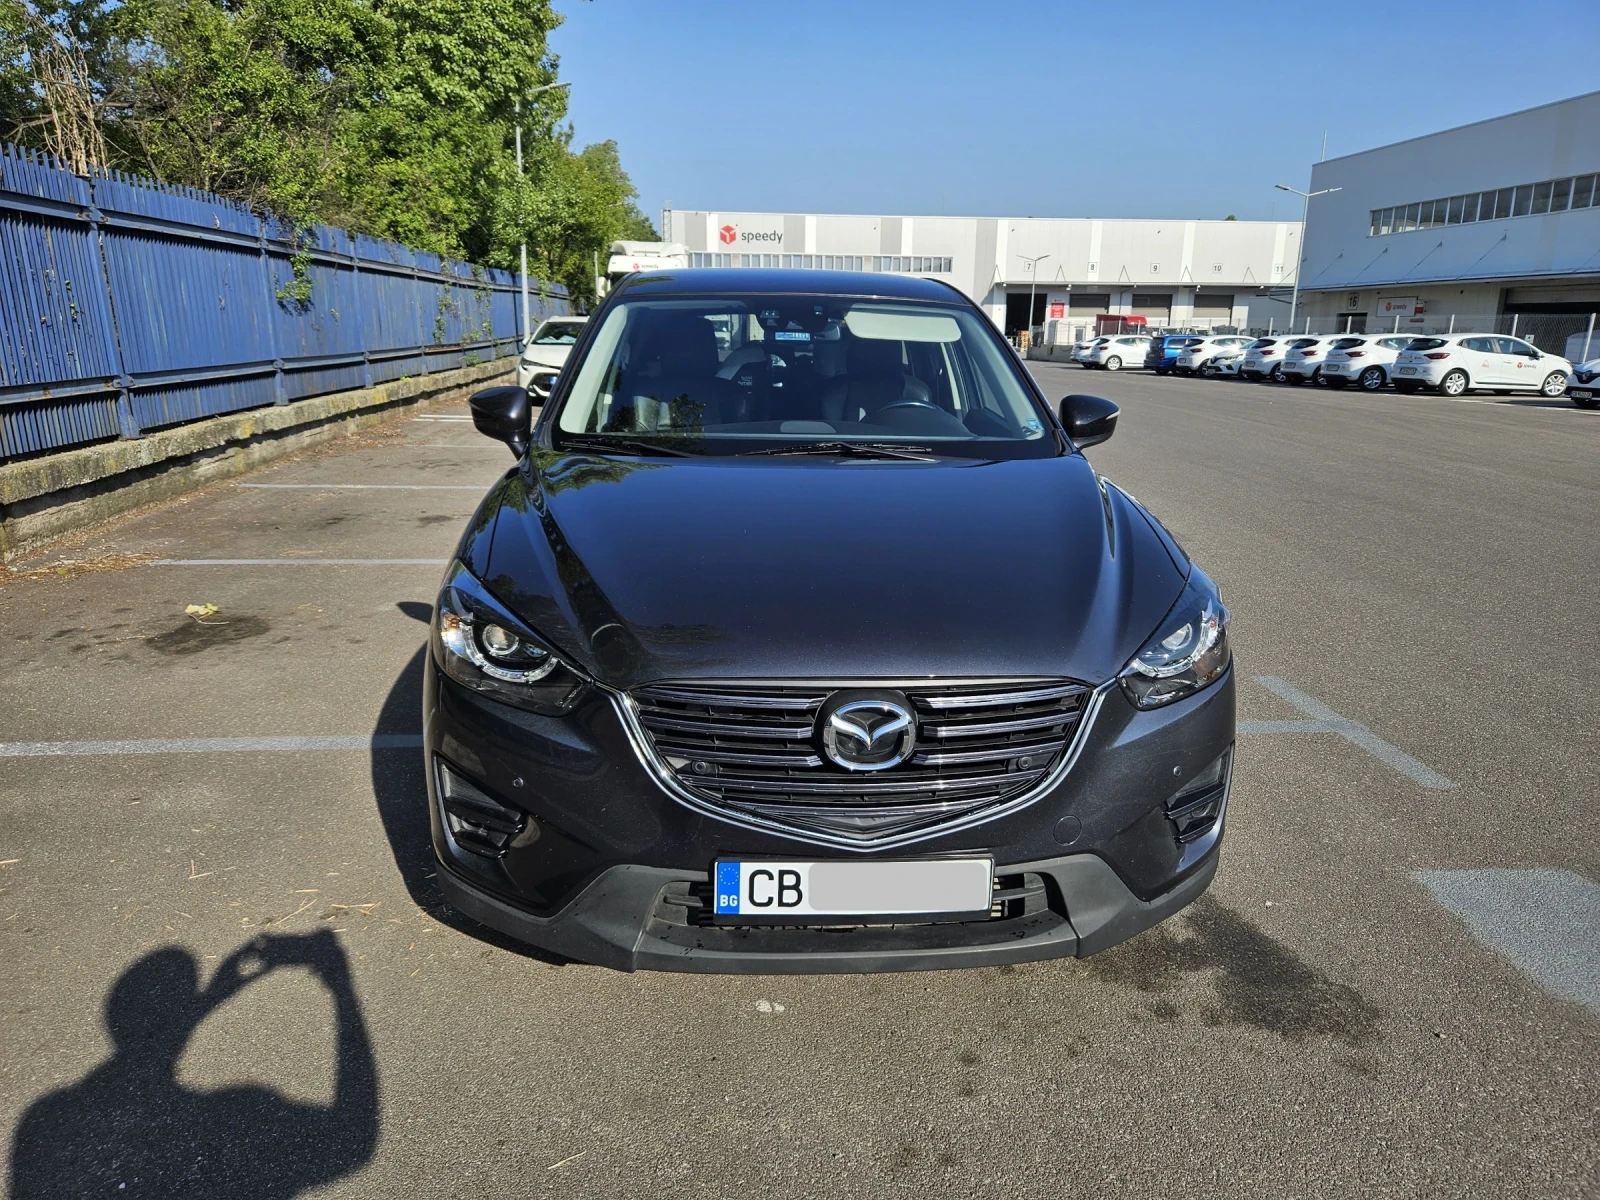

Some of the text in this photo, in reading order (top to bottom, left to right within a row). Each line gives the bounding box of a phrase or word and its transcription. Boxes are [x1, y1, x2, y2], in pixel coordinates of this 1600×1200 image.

[741, 229, 783, 244] speedy
[1214, 264, 1222, 272] 10
[1349, 296, 1357, 307] 16
[748, 869, 803, 907] CB
[720, 895, 738, 907] BG
